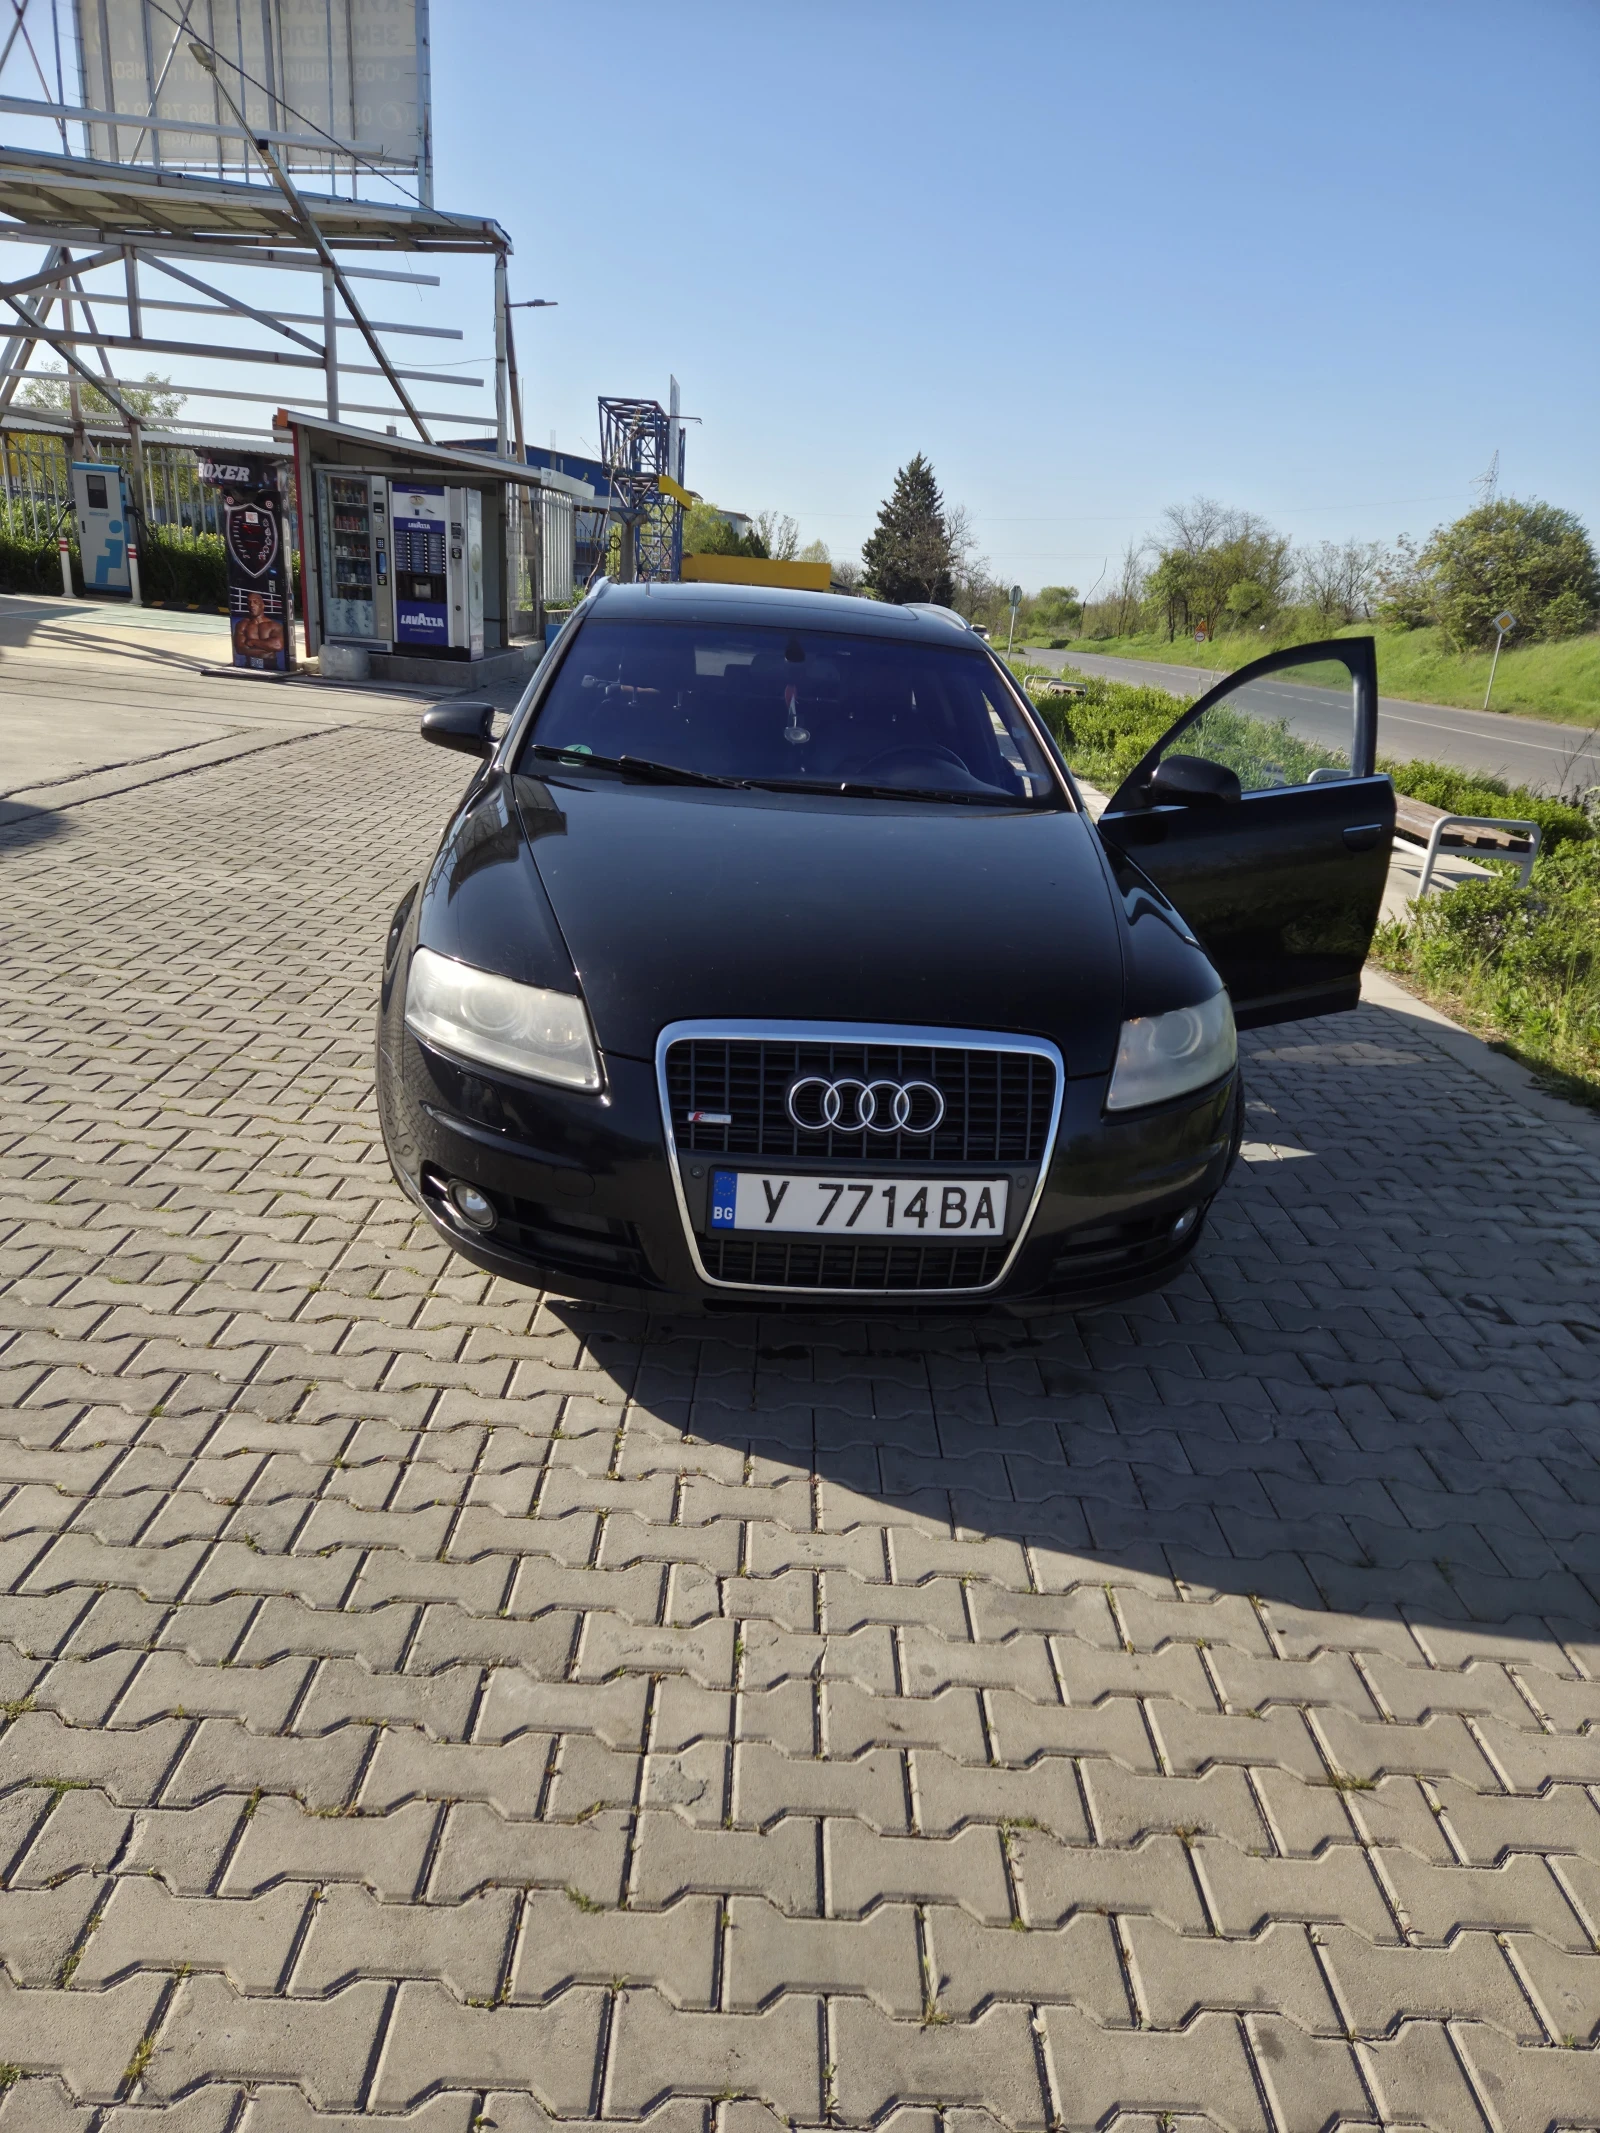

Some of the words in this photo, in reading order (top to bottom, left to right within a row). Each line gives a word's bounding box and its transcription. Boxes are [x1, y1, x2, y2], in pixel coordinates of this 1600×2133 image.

[199, 463, 250, 481] BOXER
[400, 612, 445, 628] LAVAZZA
[713, 1206, 734, 1221] BG
